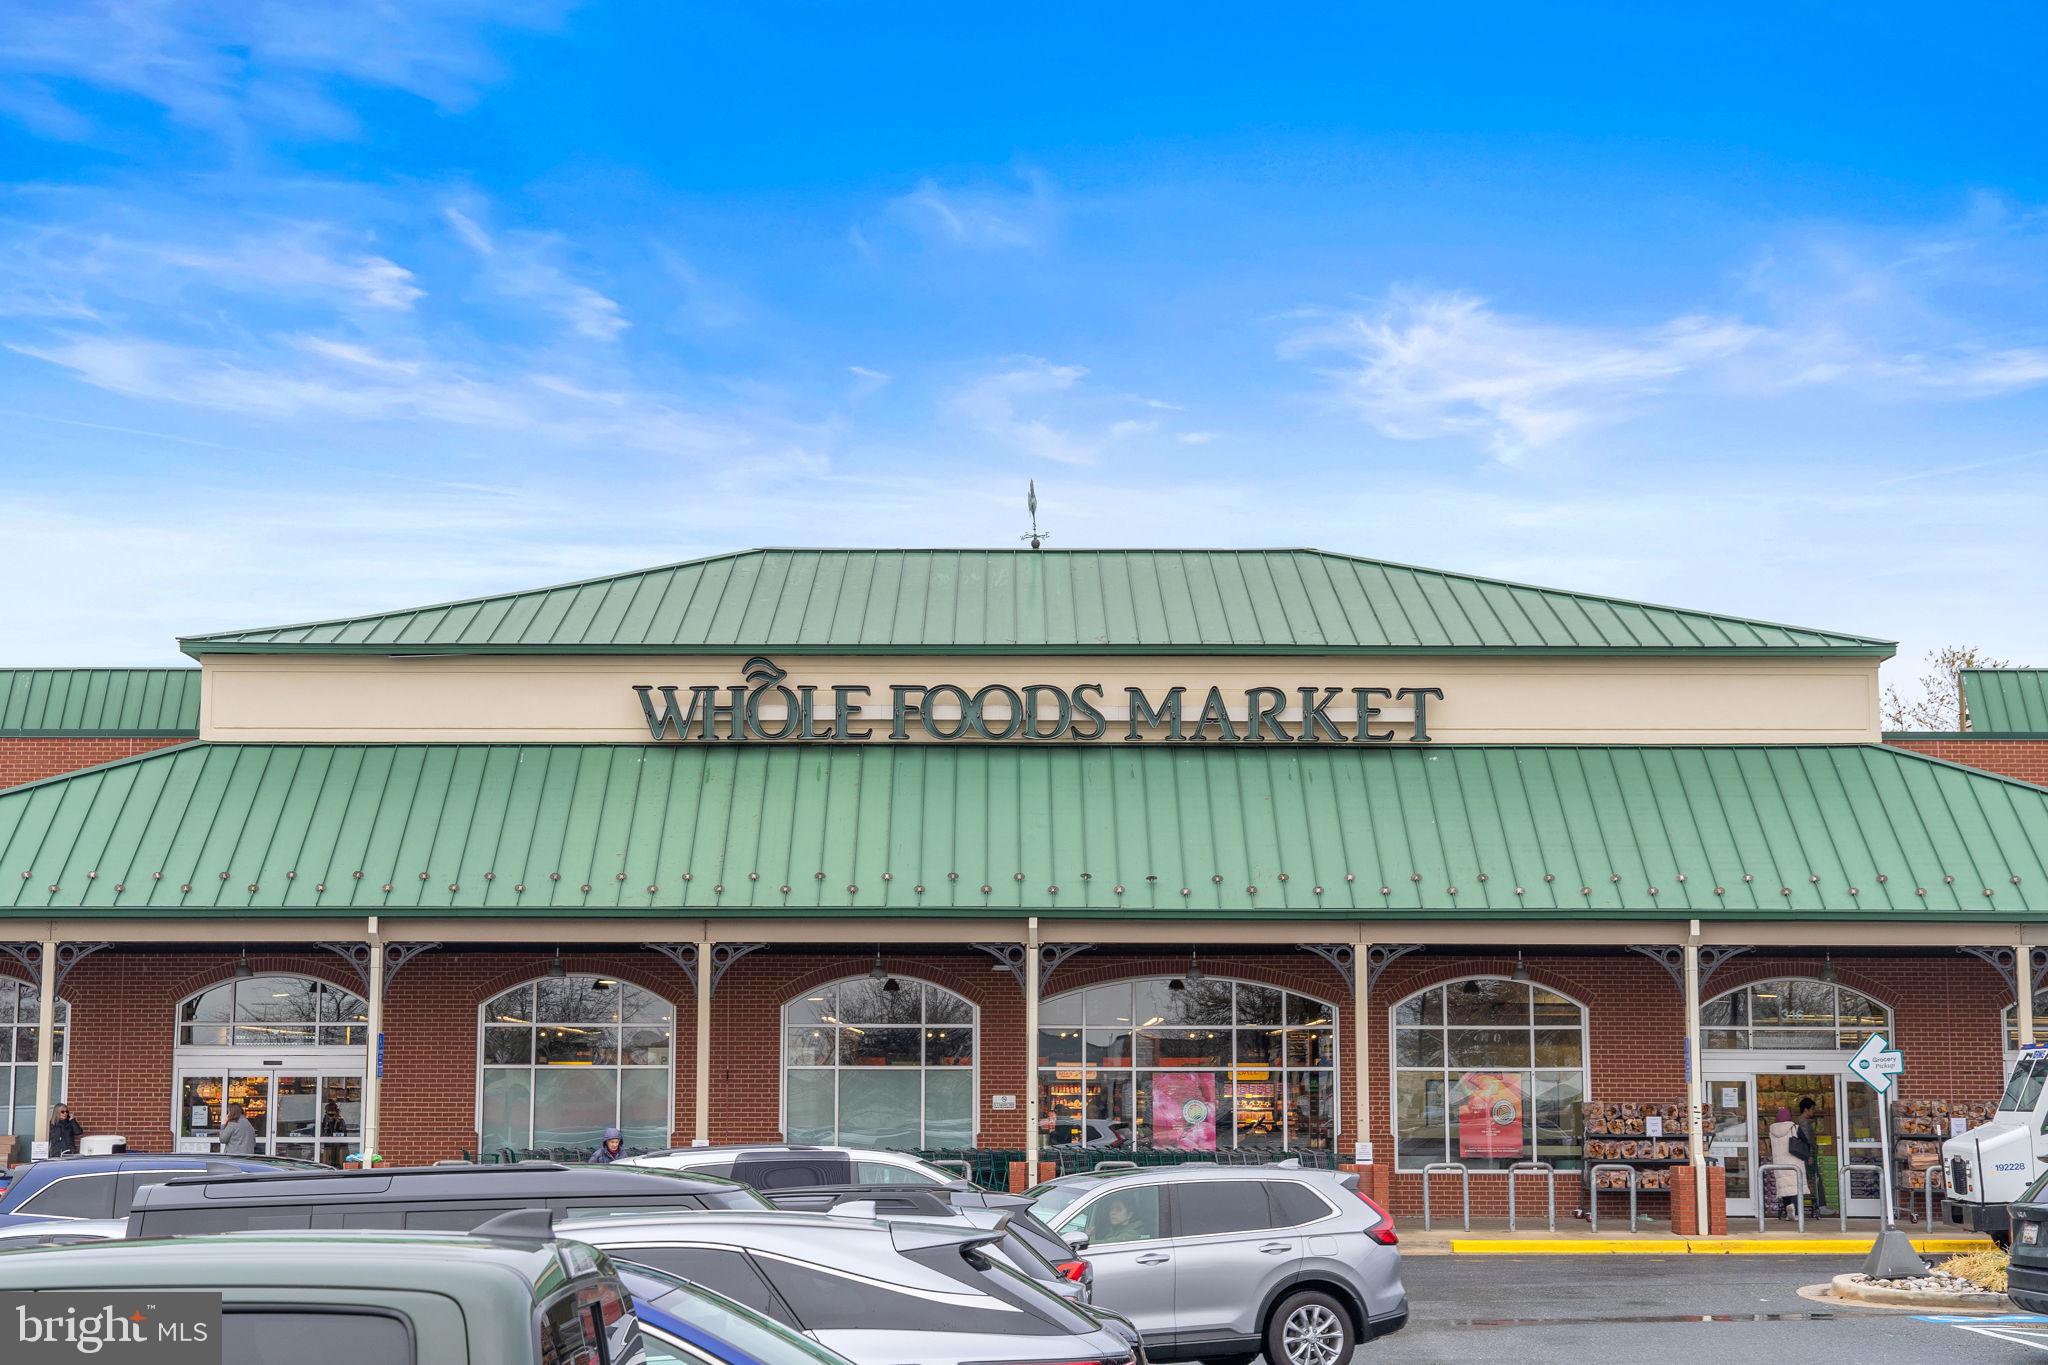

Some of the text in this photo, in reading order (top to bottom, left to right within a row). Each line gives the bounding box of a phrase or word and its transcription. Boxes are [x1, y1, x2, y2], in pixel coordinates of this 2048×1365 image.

[632, 657, 1445, 742] WHOLE FOODS MARKET
[1995, 1162, 2026, 1171] 192228
